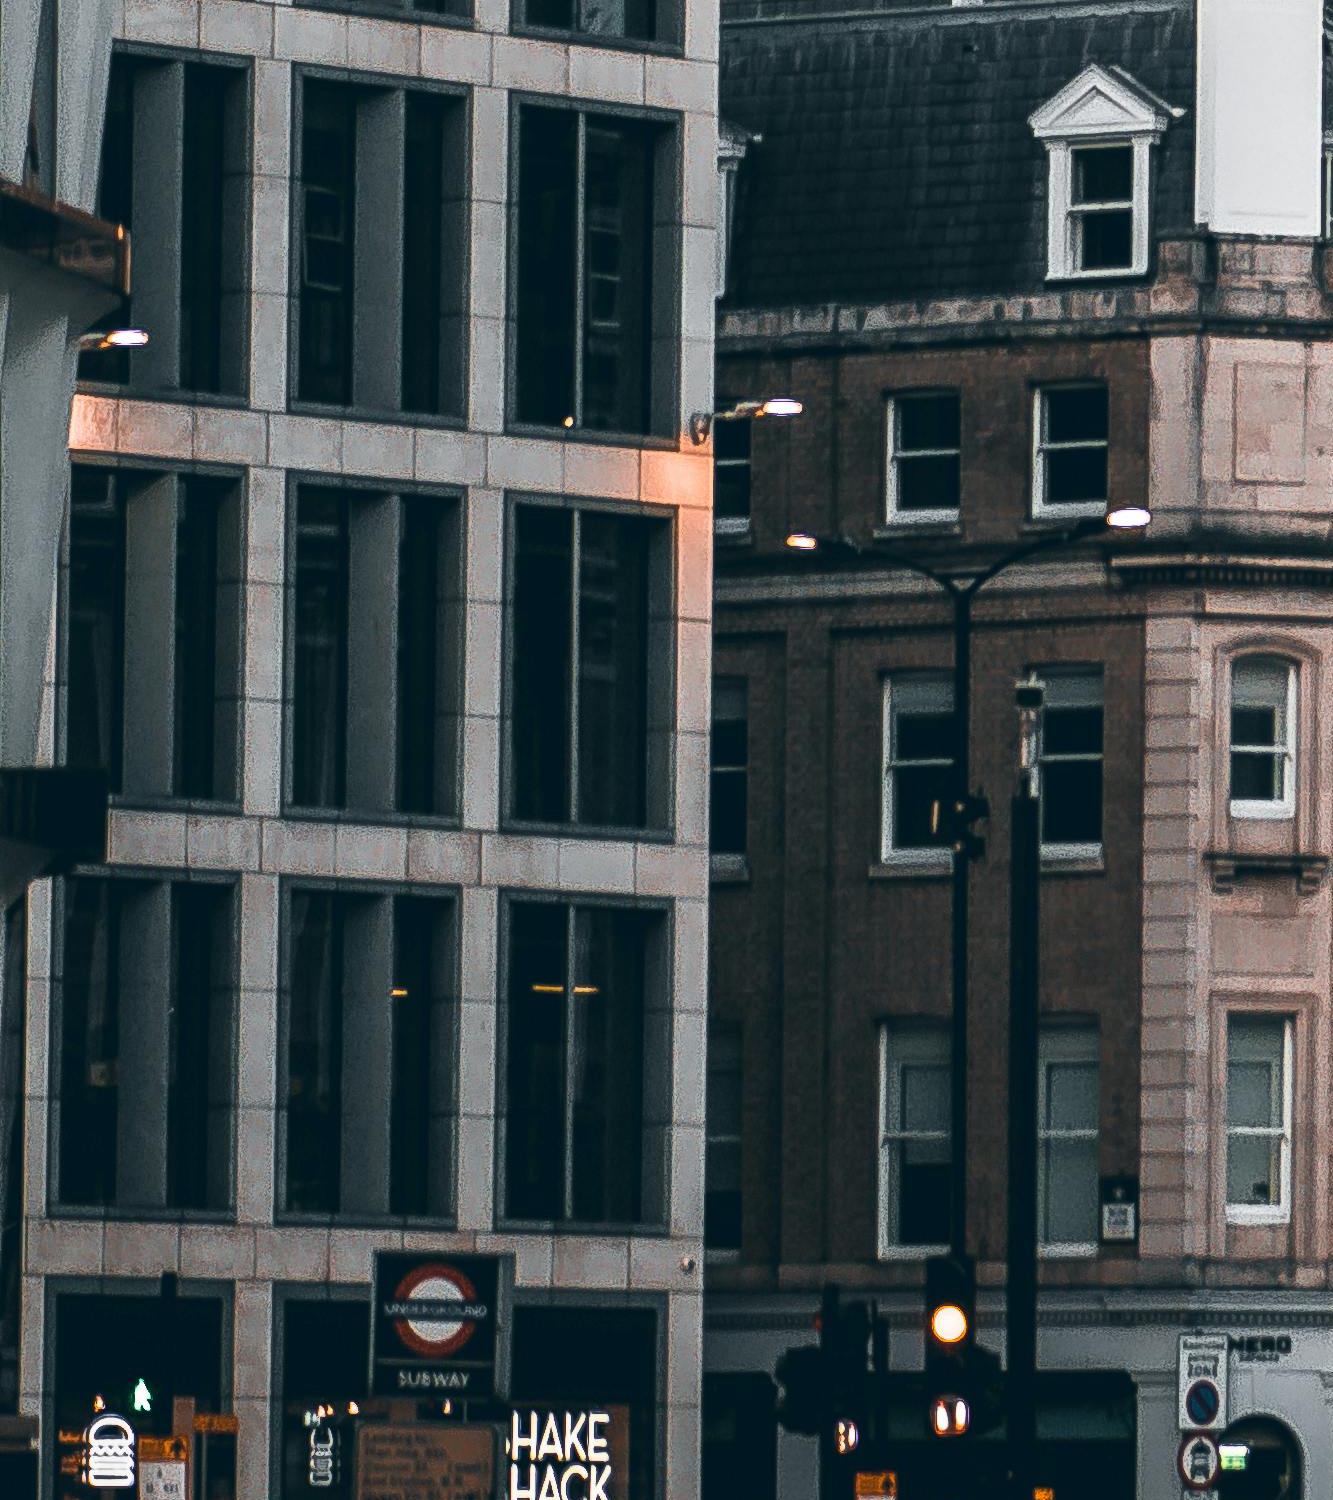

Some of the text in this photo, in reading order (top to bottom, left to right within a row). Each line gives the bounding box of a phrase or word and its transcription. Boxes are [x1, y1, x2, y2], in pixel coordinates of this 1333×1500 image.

[384, 1303, 487, 1317] UNDERGROUND
[399, 1371, 470, 1387] SUBWAY
[506, 1411, 610, 1462] HAKE
